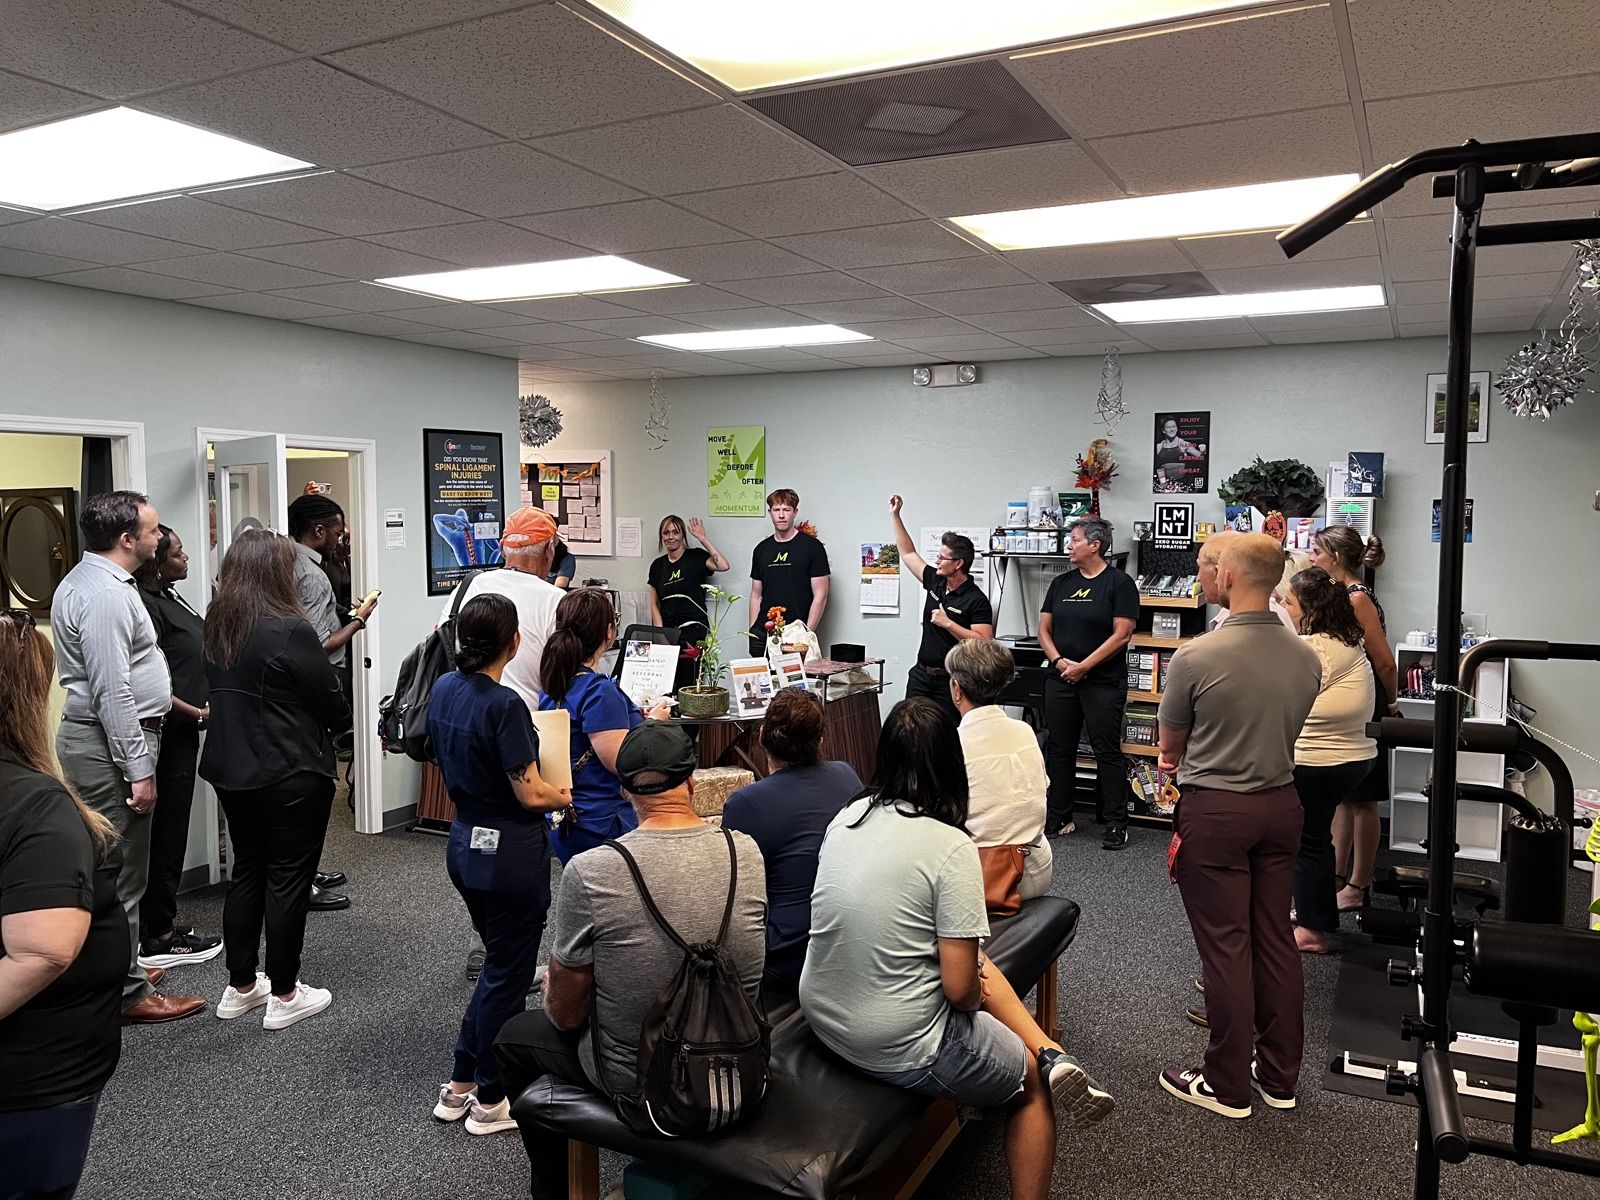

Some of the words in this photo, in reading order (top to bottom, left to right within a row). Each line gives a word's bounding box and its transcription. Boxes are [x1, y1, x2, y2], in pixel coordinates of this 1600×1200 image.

[717, 448, 736, 456] WELL
[434, 463, 461, 471] SPINAL
[462, 464, 497, 472] LIGAMENT
[726, 463, 754, 471] BEFORE
[451, 471, 483, 479] INJURIES
[437, 580, 451, 588] TIME
